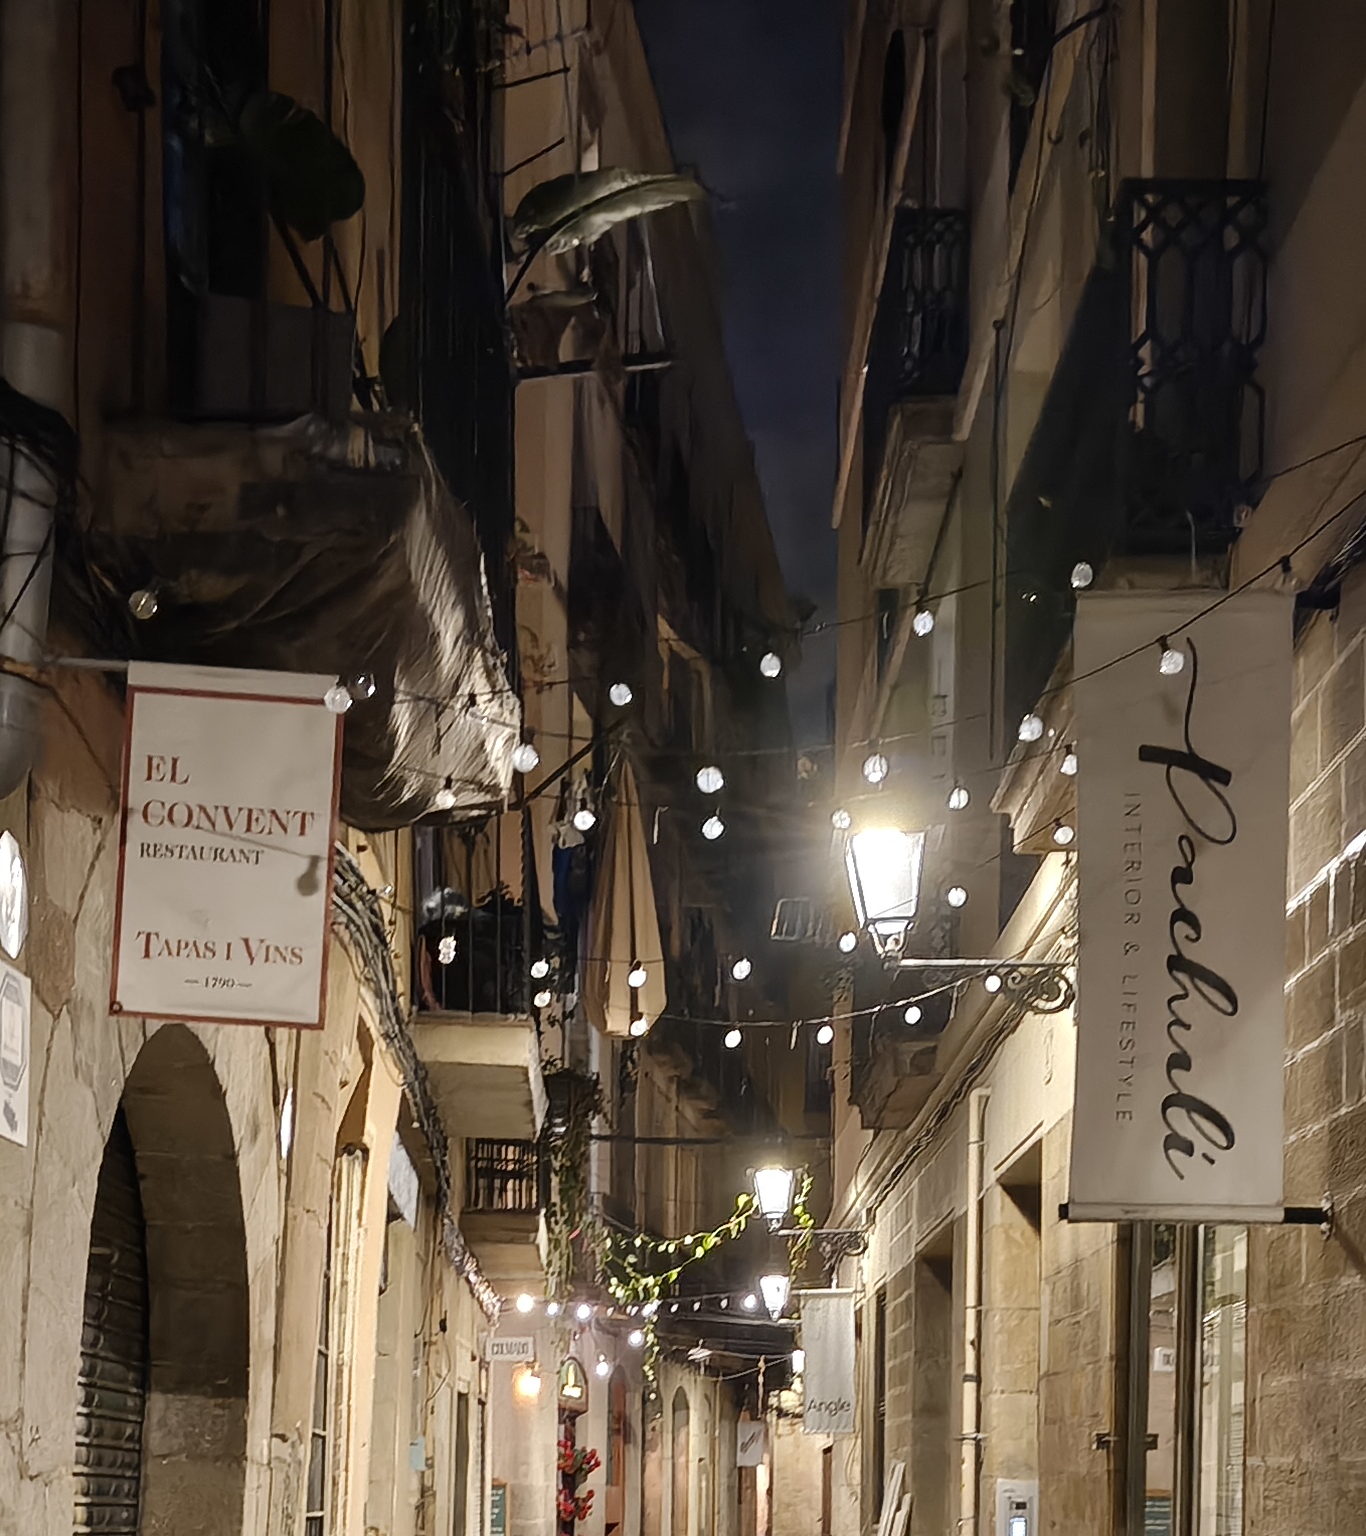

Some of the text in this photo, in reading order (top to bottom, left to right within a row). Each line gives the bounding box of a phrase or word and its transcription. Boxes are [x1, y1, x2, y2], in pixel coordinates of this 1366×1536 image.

[145, 754, 190, 785] EL
[141, 799, 315, 836] CONVENT
[139, 842, 264, 865] RESTAURANT
[1137, 636, 1238, 1181] Pachuli
[1115, 791, 1142, 1124] INTERIOR & LIFESTYLE
